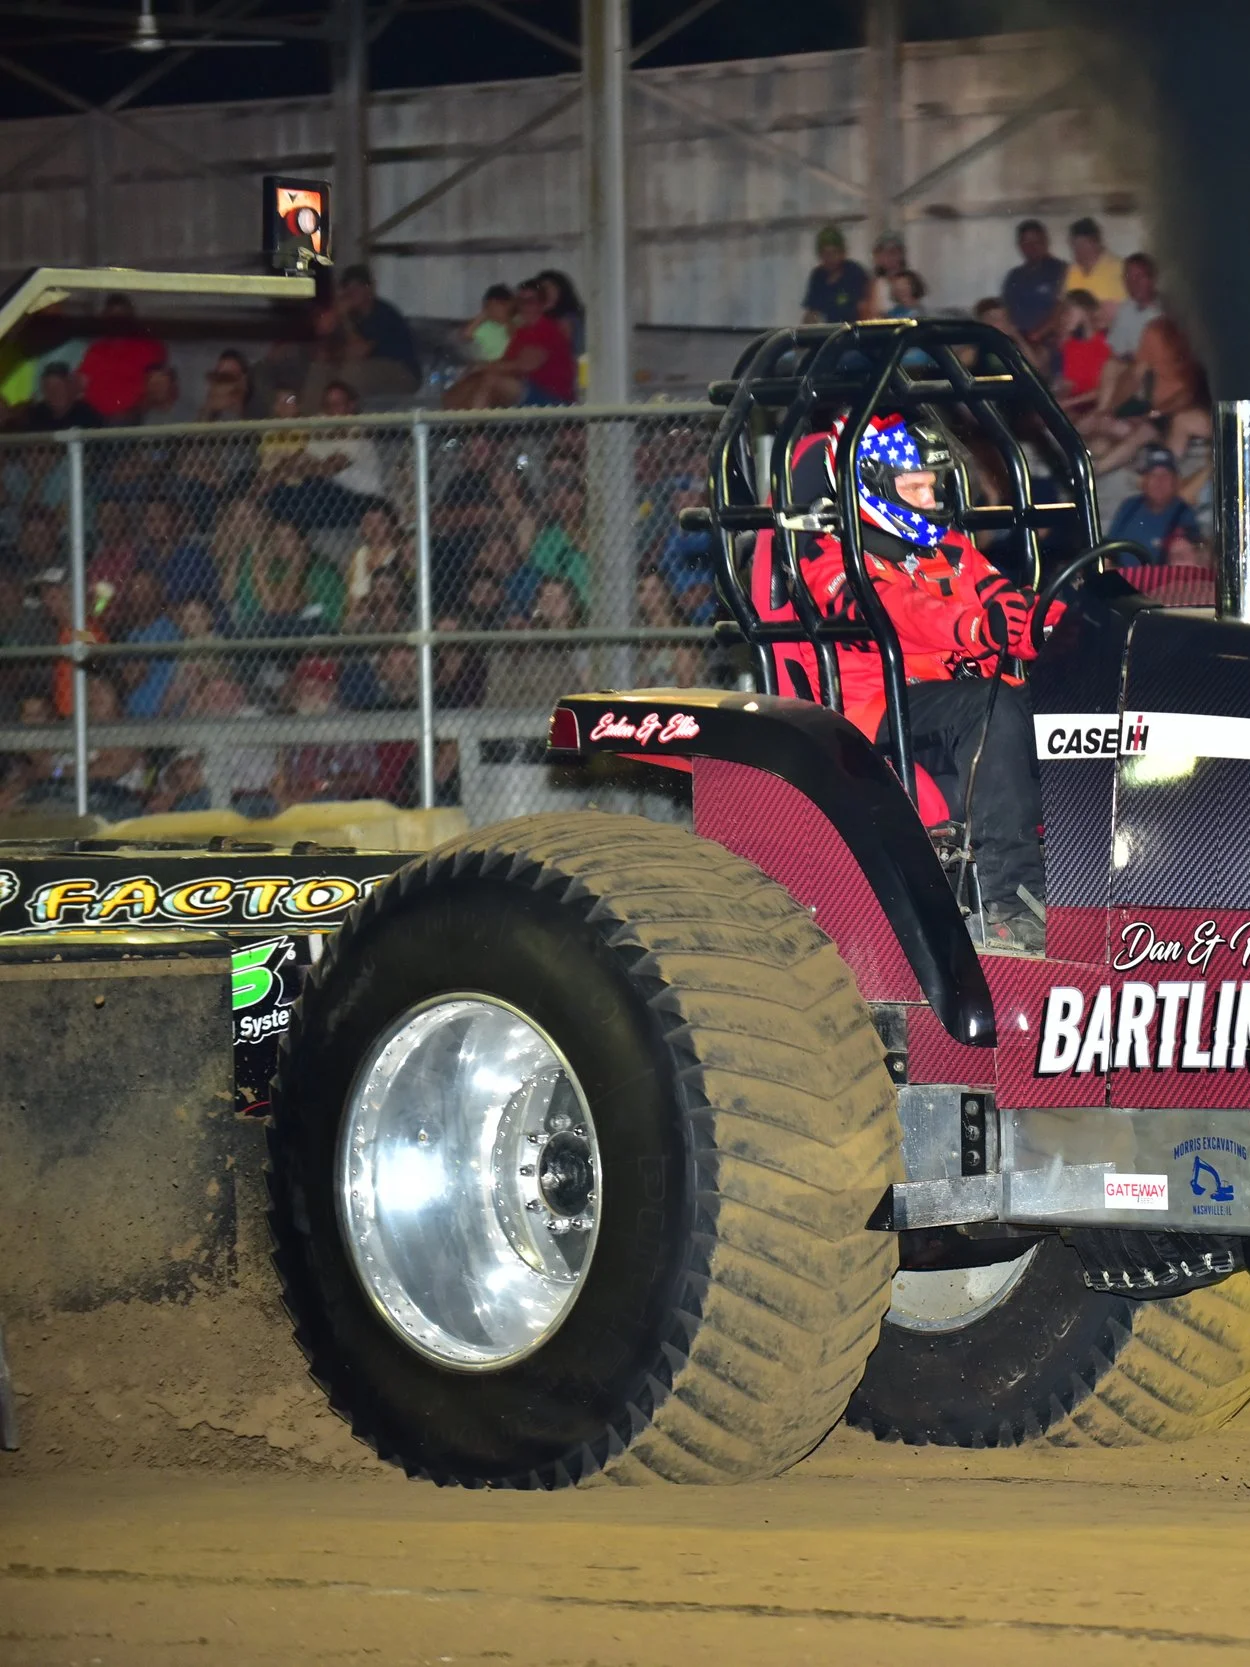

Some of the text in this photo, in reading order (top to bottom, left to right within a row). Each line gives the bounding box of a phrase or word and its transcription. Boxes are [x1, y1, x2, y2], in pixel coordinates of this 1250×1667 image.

[634, 712, 662, 746] &
[1046, 726, 1118, 755] CASE
[30, 876, 388, 924] FACTO
[1114, 923, 1182, 971] Dan
[1188, 921, 1227, 974] &
[240, 1009, 290, 1038] Syste
[1173, 1136, 1247, 1160] MORRIS EXCAVATING
[1105, 1183, 1166, 1197] GATEWAY
